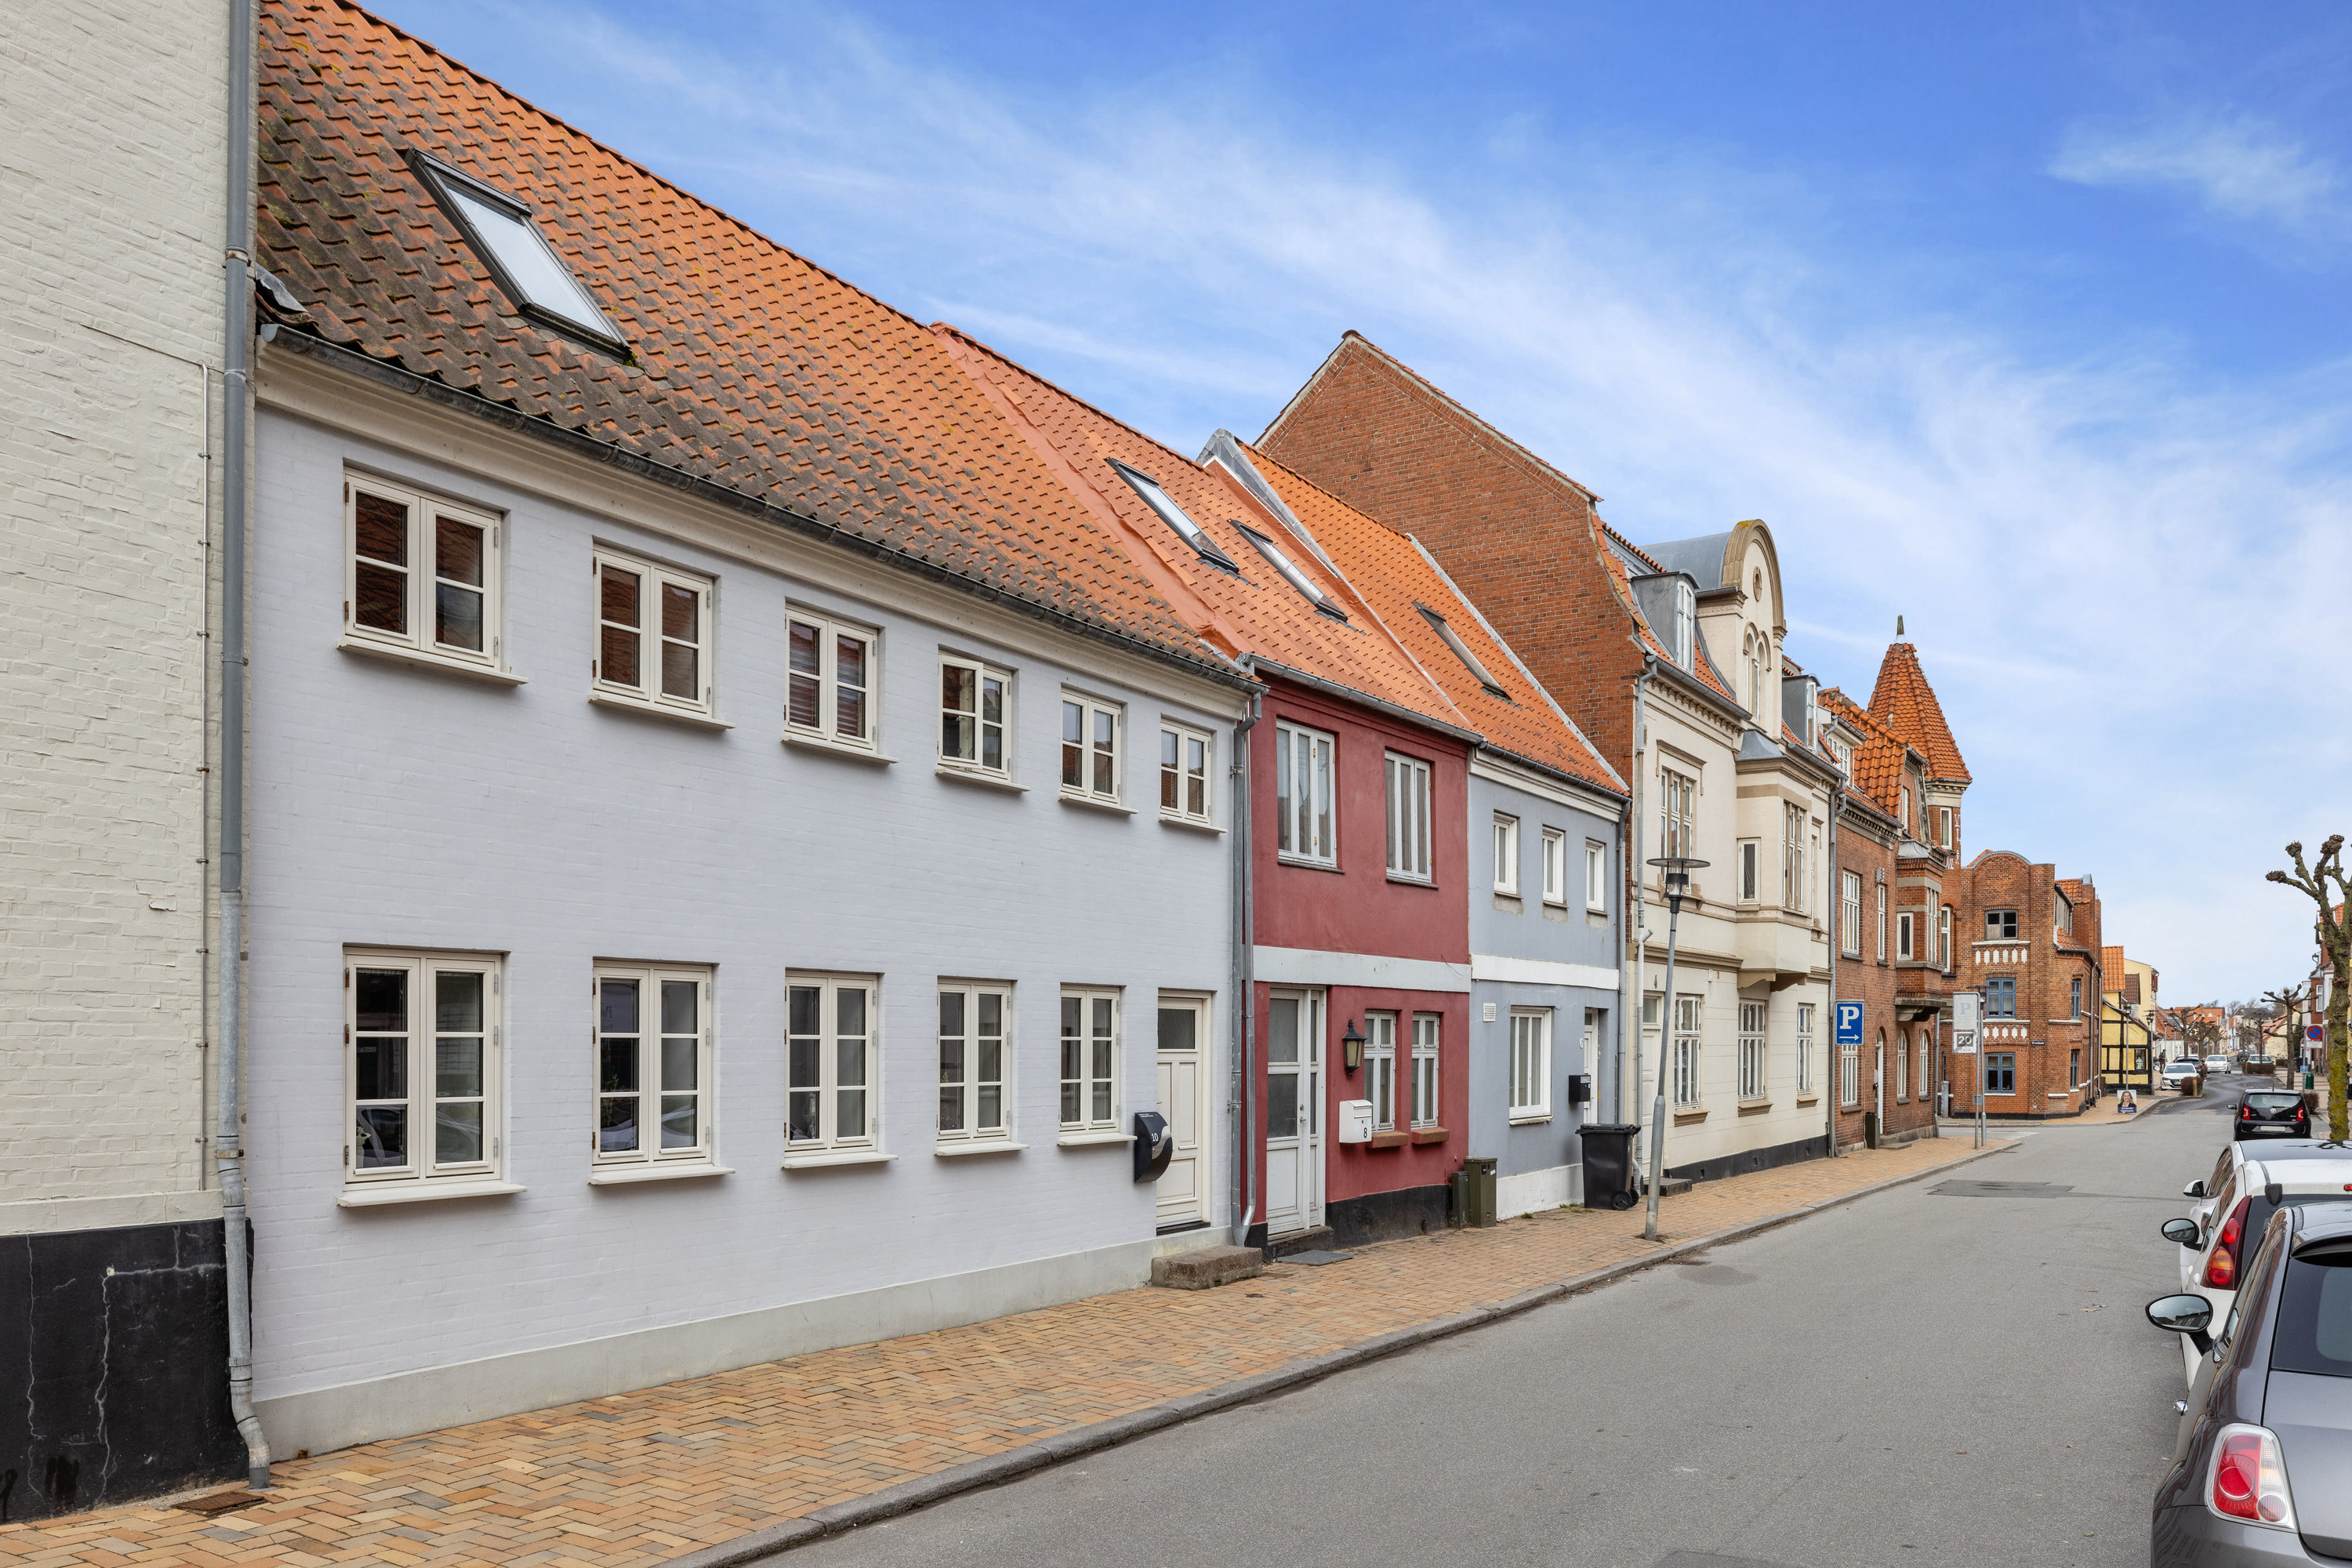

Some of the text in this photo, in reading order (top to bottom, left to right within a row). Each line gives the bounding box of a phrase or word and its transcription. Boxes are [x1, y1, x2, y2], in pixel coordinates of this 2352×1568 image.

[1961, 1003, 1971, 1014] P
[1840, 1007, 1859, 1029] P
[1580, 1038, 1584, 1048] 6
[1958, 1036, 1972, 1044] 20
[1151, 1133, 1159, 1142] 10
[1363, 1127, 1368, 1138] 8
